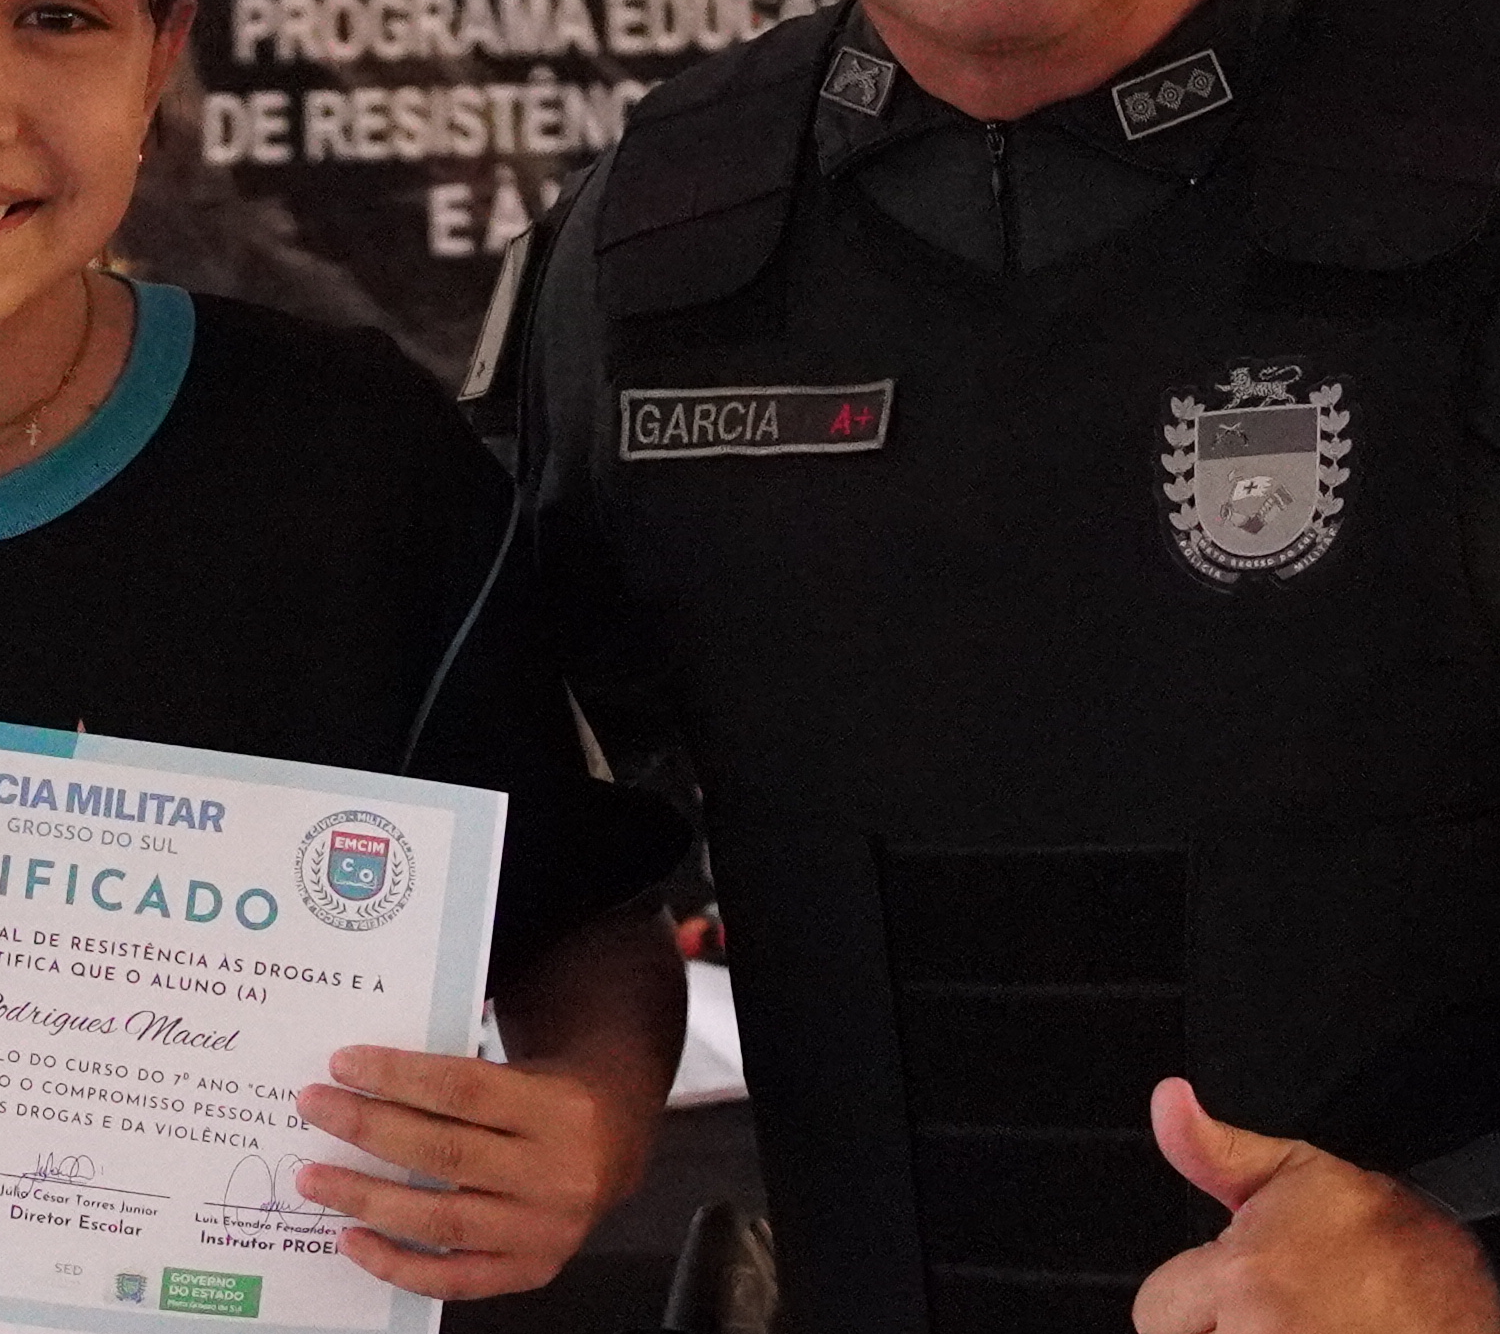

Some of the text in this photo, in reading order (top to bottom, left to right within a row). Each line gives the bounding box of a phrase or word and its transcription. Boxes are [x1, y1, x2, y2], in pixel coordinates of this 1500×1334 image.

[201, 67, 665, 167] DE RESISTÊNC
[427, 181, 474, 257] E
[634, 401, 875, 445] GARCIA A+
[65, 782, 226, 833] MILITAR
[7, 817, 93, 842] GROSSO
[101, 830, 133, 848] DO
[140, 835, 178, 855] SUL
[334, 836, 385, 854] EMCIM
[33, 931, 60, 948] DE
[71, 936, 208, 968] RESISTÊNCIA
[218, 953, 244, 973] ÀS
[254, 961, 342, 986] DROGAS
[352, 975, 362, 990] E
[373, 975, 384, 993] À
[71, 962, 115, 981] QUE
[126, 969, 141, 984] O
[151, 974, 227, 996] ALUNO
[237, 985, 267, 1005] (A)
[125, 1010, 240, 1052] Maciel
[30, 1053, 57, 1068] DO
[65, 1058, 128, 1078] CURSO
[138, 1068, 165, 1084] DO
[197, 1077, 239, 1094] ANO
[248, 1083, 301, 1102] "CAIN
[16, 1103, 93, 1127] DROGAS
[102, 1115, 113, 1129] E
[121, 1117, 146, 1134] DA
[20, 1077, 33, 1091] O
[42, 1080, 185, 1112] COMPROMISSO
[194, 1101, 277, 1126] PESSOAL
[286, 1114, 310, 1131] DE
[10, 1204, 142, 1237] Diretor Escolar
[33, 1188, 69, 1205] César
[76, 1194, 115, 1210] Torres
[119, 1200, 158, 1216] Junior
[201, 1230, 339, 1255] Instrutor PROE
[54, 1262, 83, 1276] SED
[170, 1272, 236, 1289] GOVERNO
[169, 1285, 245, 1302] DO ESTADO
